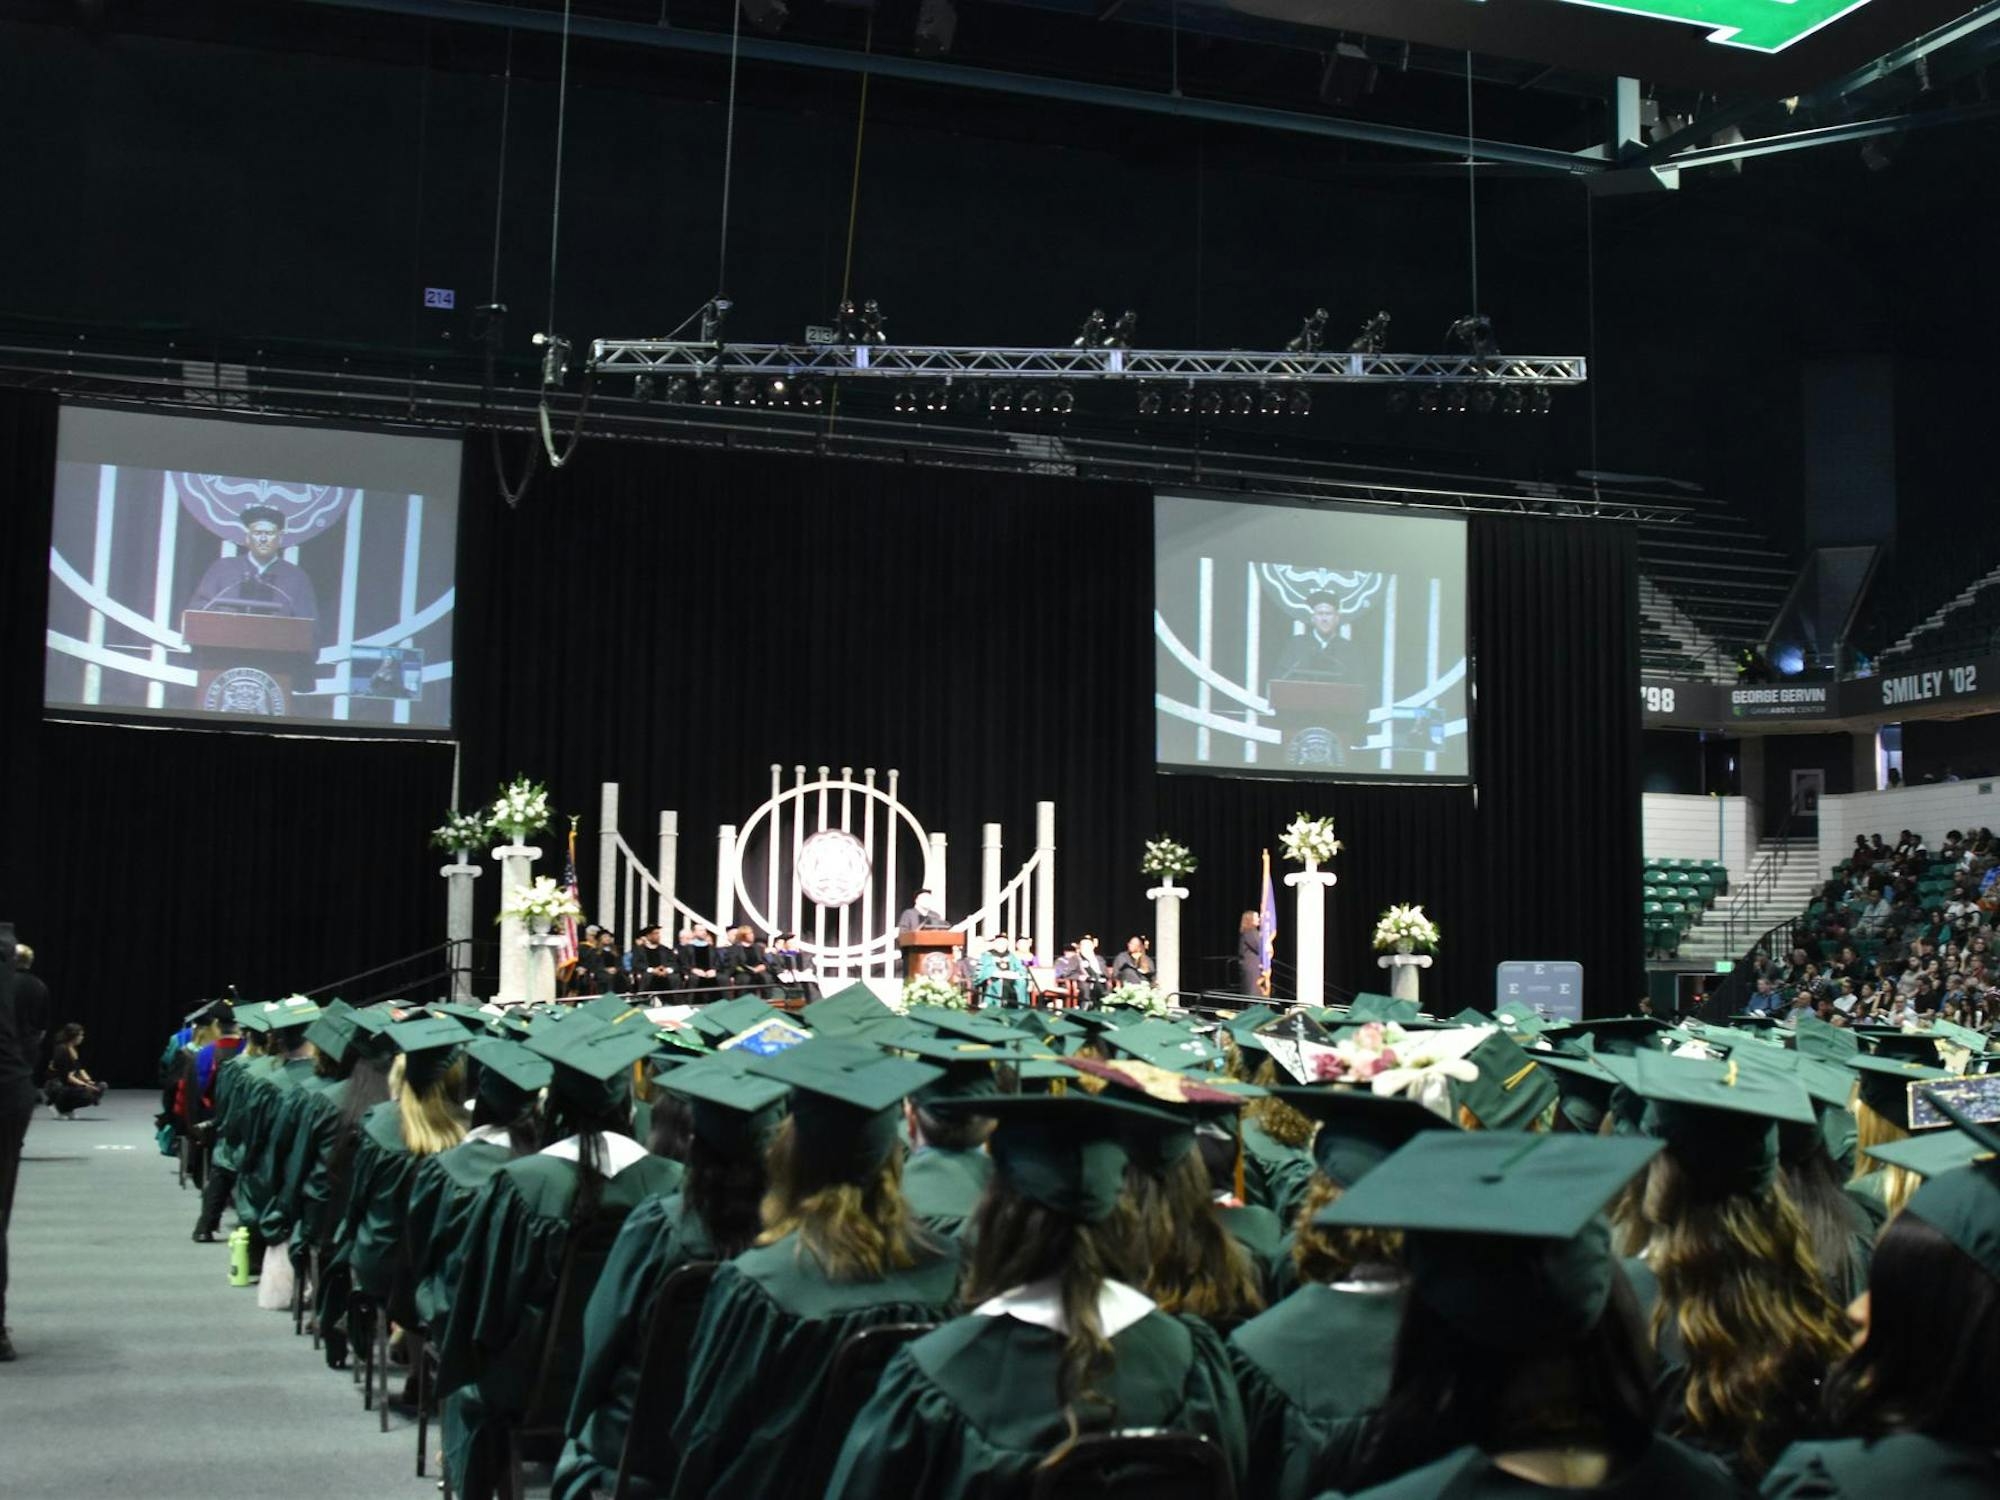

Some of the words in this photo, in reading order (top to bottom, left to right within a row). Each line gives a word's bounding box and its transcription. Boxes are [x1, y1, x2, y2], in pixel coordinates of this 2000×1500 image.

[427, 290, 452, 305] 214
[808, 328, 831, 342] 213
[1882, 670, 1943, 705] SMILEY
[1948, 665, 1977, 693] '02
[1640, 686, 1675, 713] '98
[1732, 690, 1779, 704] GEORGE
[1780, 688, 1826, 702] GERVIN
[1534, 964, 1545, 975] E
[1508, 983, 1519, 994] E
[1559, 983, 1570, 994] E
